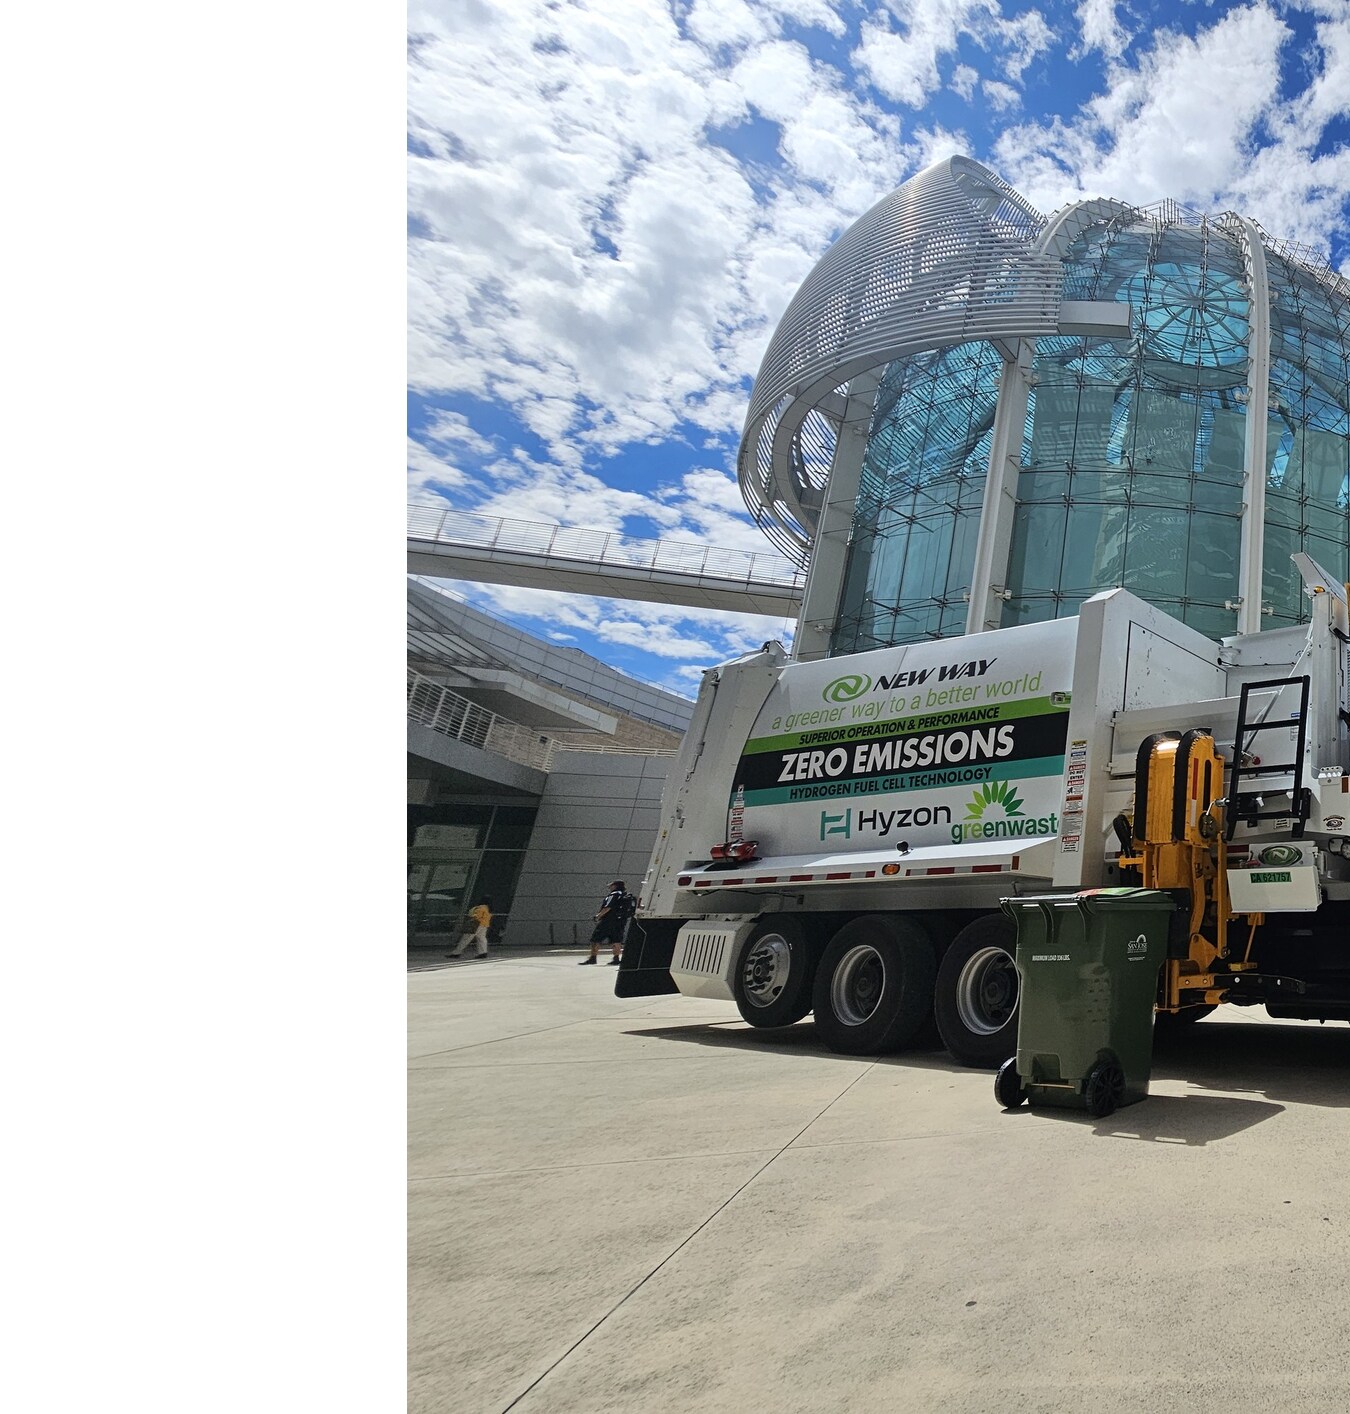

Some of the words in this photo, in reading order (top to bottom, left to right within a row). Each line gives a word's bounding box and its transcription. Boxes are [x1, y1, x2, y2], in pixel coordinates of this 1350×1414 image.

[873, 667, 936, 691] NEW
[938, 657, 998, 680] WAY
[771, 716, 782, 730] a
[784, 705, 845, 732] greener
[851, 700, 884, 720] way
[889, 696, 905, 713] to
[910, 695, 921, 710] a
[925, 684, 981, 707] better
[986, 671, 1042, 698] world
[799, 728, 845, 745] SUPERIOR
[847, 721, 906, 739] OPERATION
[907, 718, 916, 730] &
[918, 707, 1000, 729] PERFORMANCE
[777, 747, 848, 783] ZERO
[852, 725, 1015, 774] EMISSIONS
[789, 783, 851, 800] HYDROGEN
[853, 780, 880, 794] FUEL
[882, 777, 908, 791] CELL
[909, 767, 993, 788] TECHNOLOGY
[858, 805, 951, 837] Hyzon
[951, 813, 1059, 845] greenwast
[1251, 873, 1262, 883] CA
